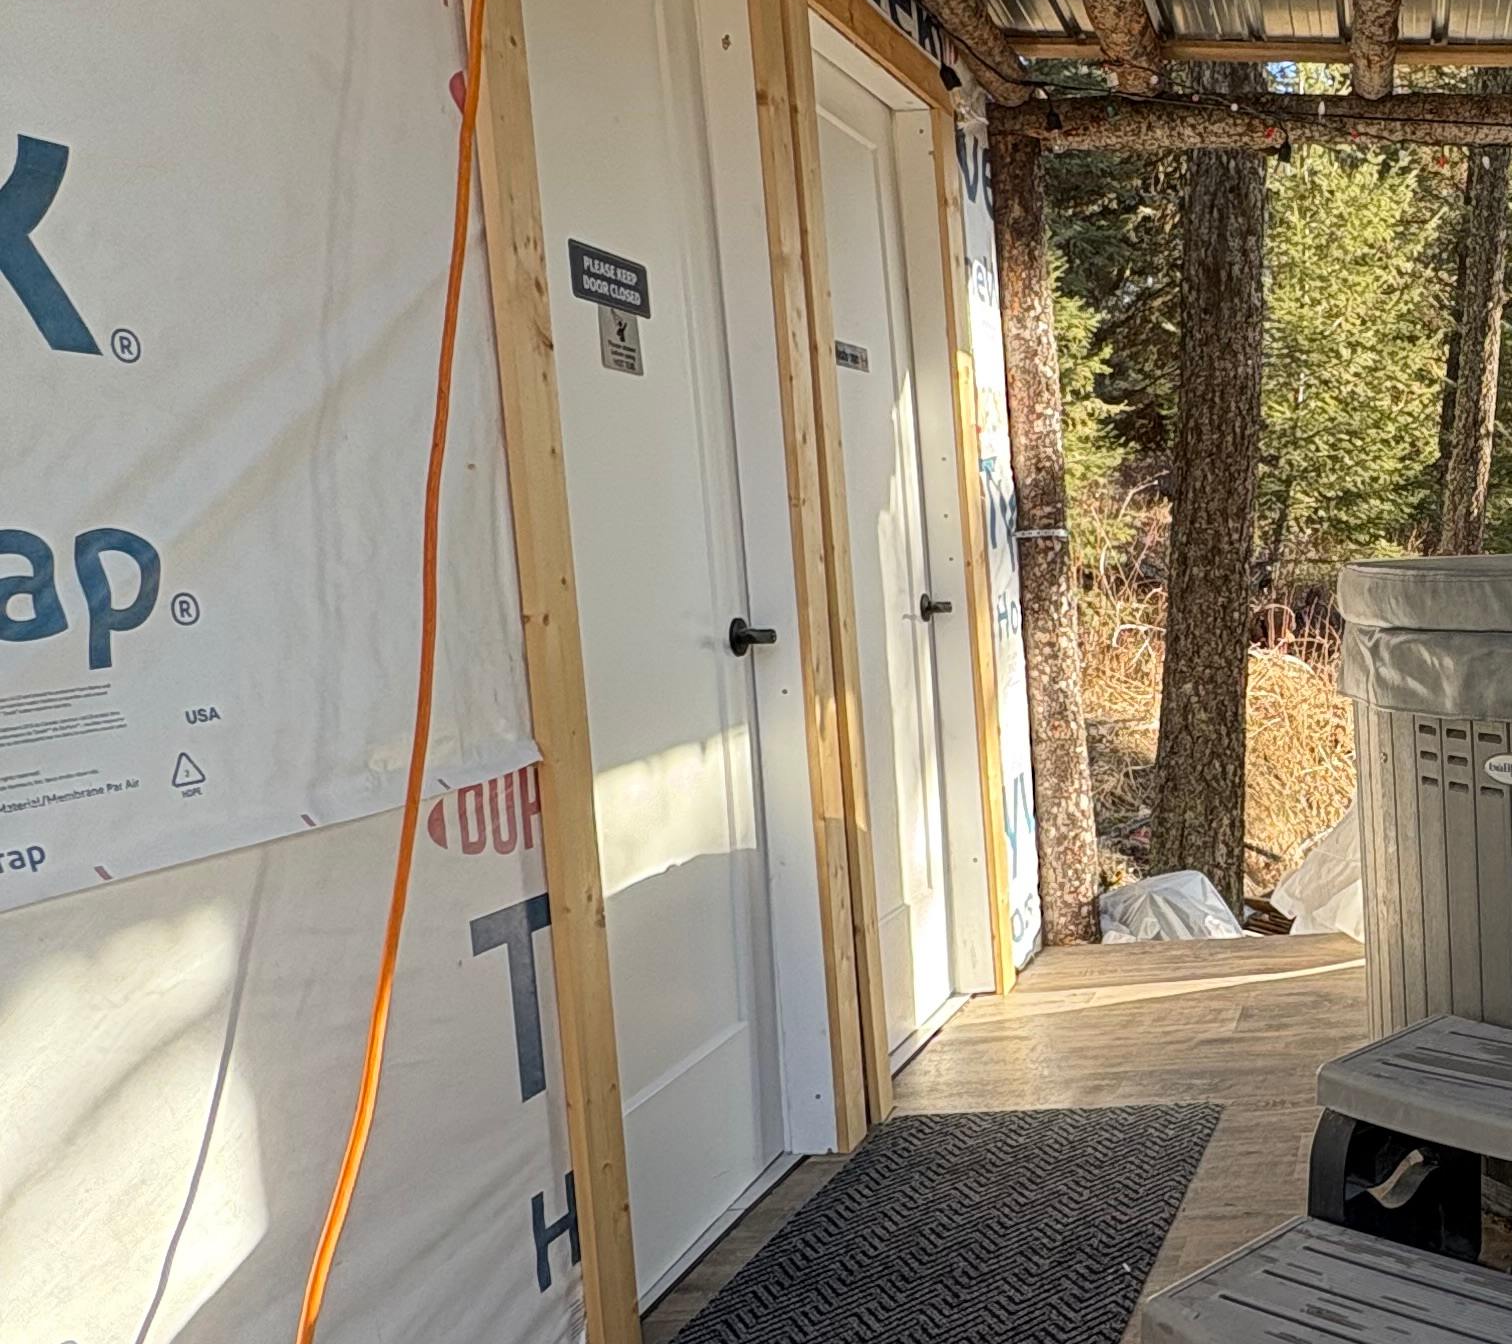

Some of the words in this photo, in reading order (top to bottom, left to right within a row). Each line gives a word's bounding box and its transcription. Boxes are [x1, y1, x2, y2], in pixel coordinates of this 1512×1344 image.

[583, 255, 616, 280] PLEASE
[616, 267, 638, 286] KEEP
[583, 274, 610, 296] DOOR
[609, 283, 641, 306] CLOSED
[184, 707, 221, 725] USA
